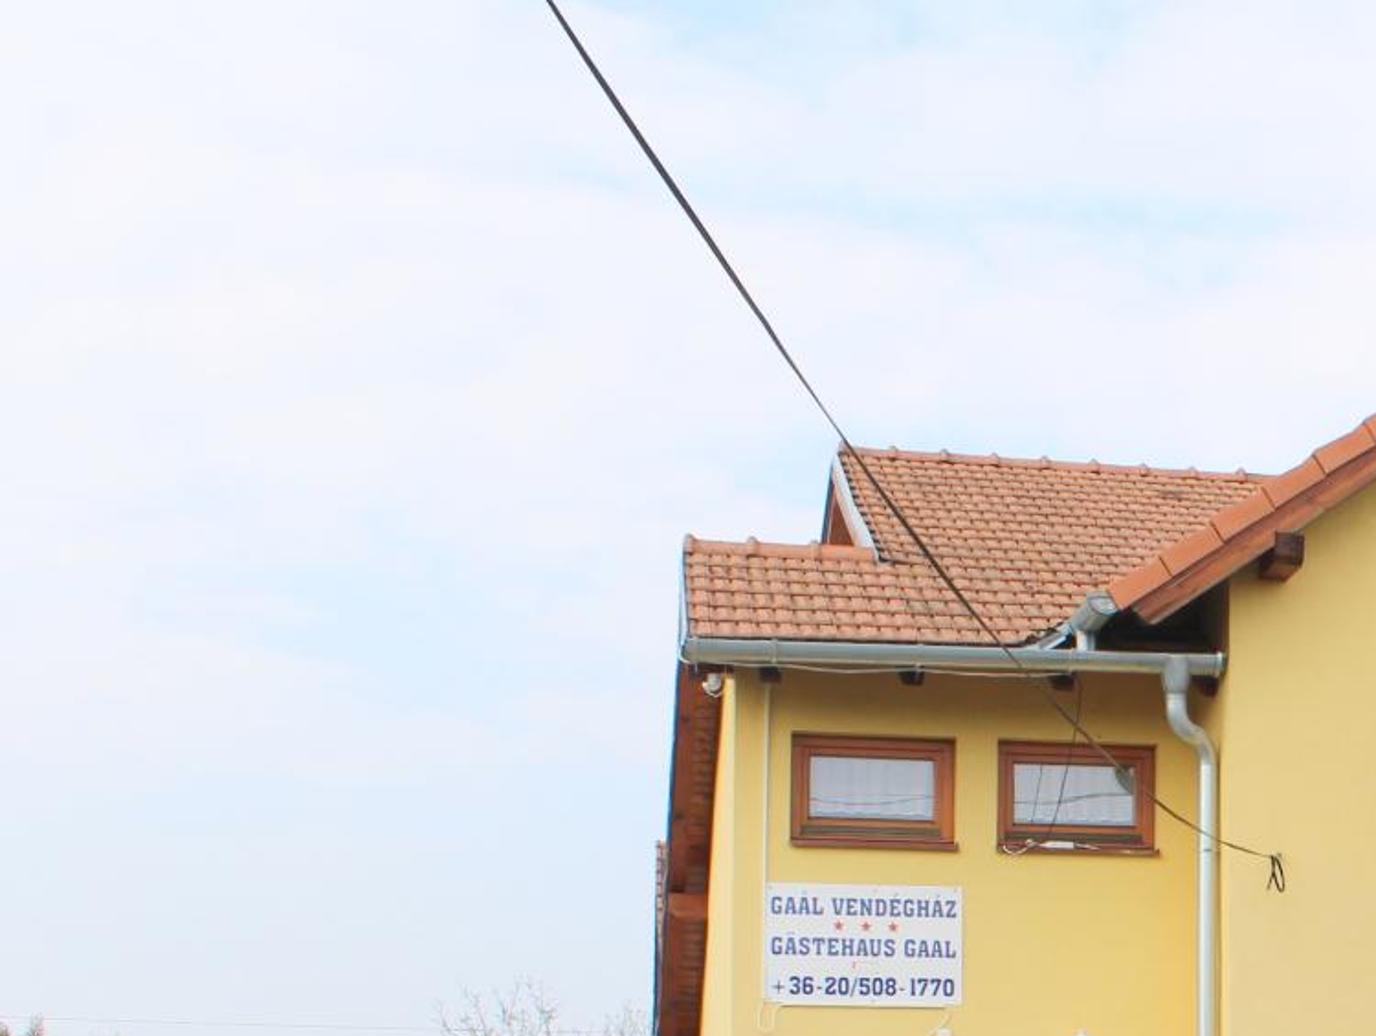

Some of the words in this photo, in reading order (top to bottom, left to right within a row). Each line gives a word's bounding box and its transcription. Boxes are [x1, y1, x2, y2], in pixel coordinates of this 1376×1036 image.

[831, 893, 957, 918] VENDÉGHÁZ
[771, 931, 896, 957] GÄSTEHAUS
[904, 939, 957, 959] GAAL
